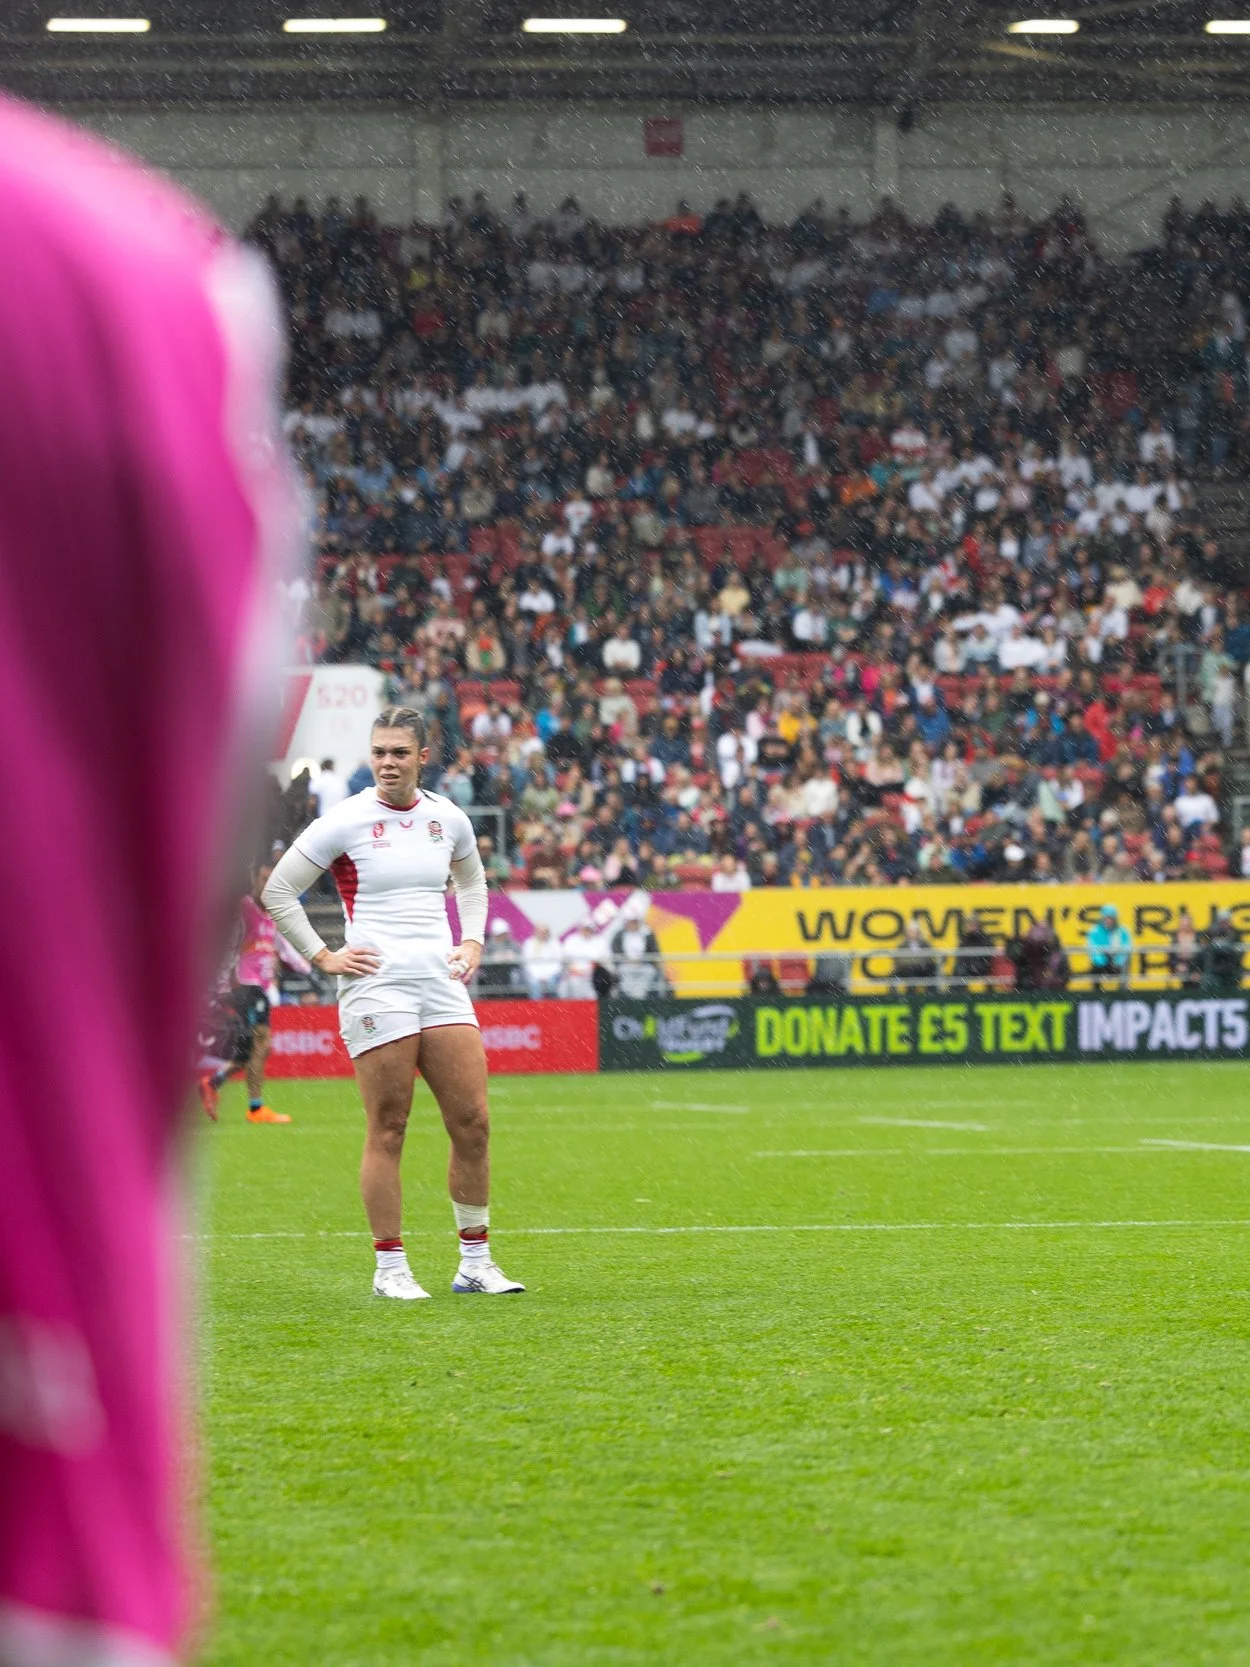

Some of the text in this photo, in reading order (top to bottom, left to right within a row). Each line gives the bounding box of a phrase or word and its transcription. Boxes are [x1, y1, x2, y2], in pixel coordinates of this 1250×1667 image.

[755, 1005, 912, 1056] DONATE
[918, 1003, 968, 1054] £5
[974, 1001, 1072, 1052] TEXT
